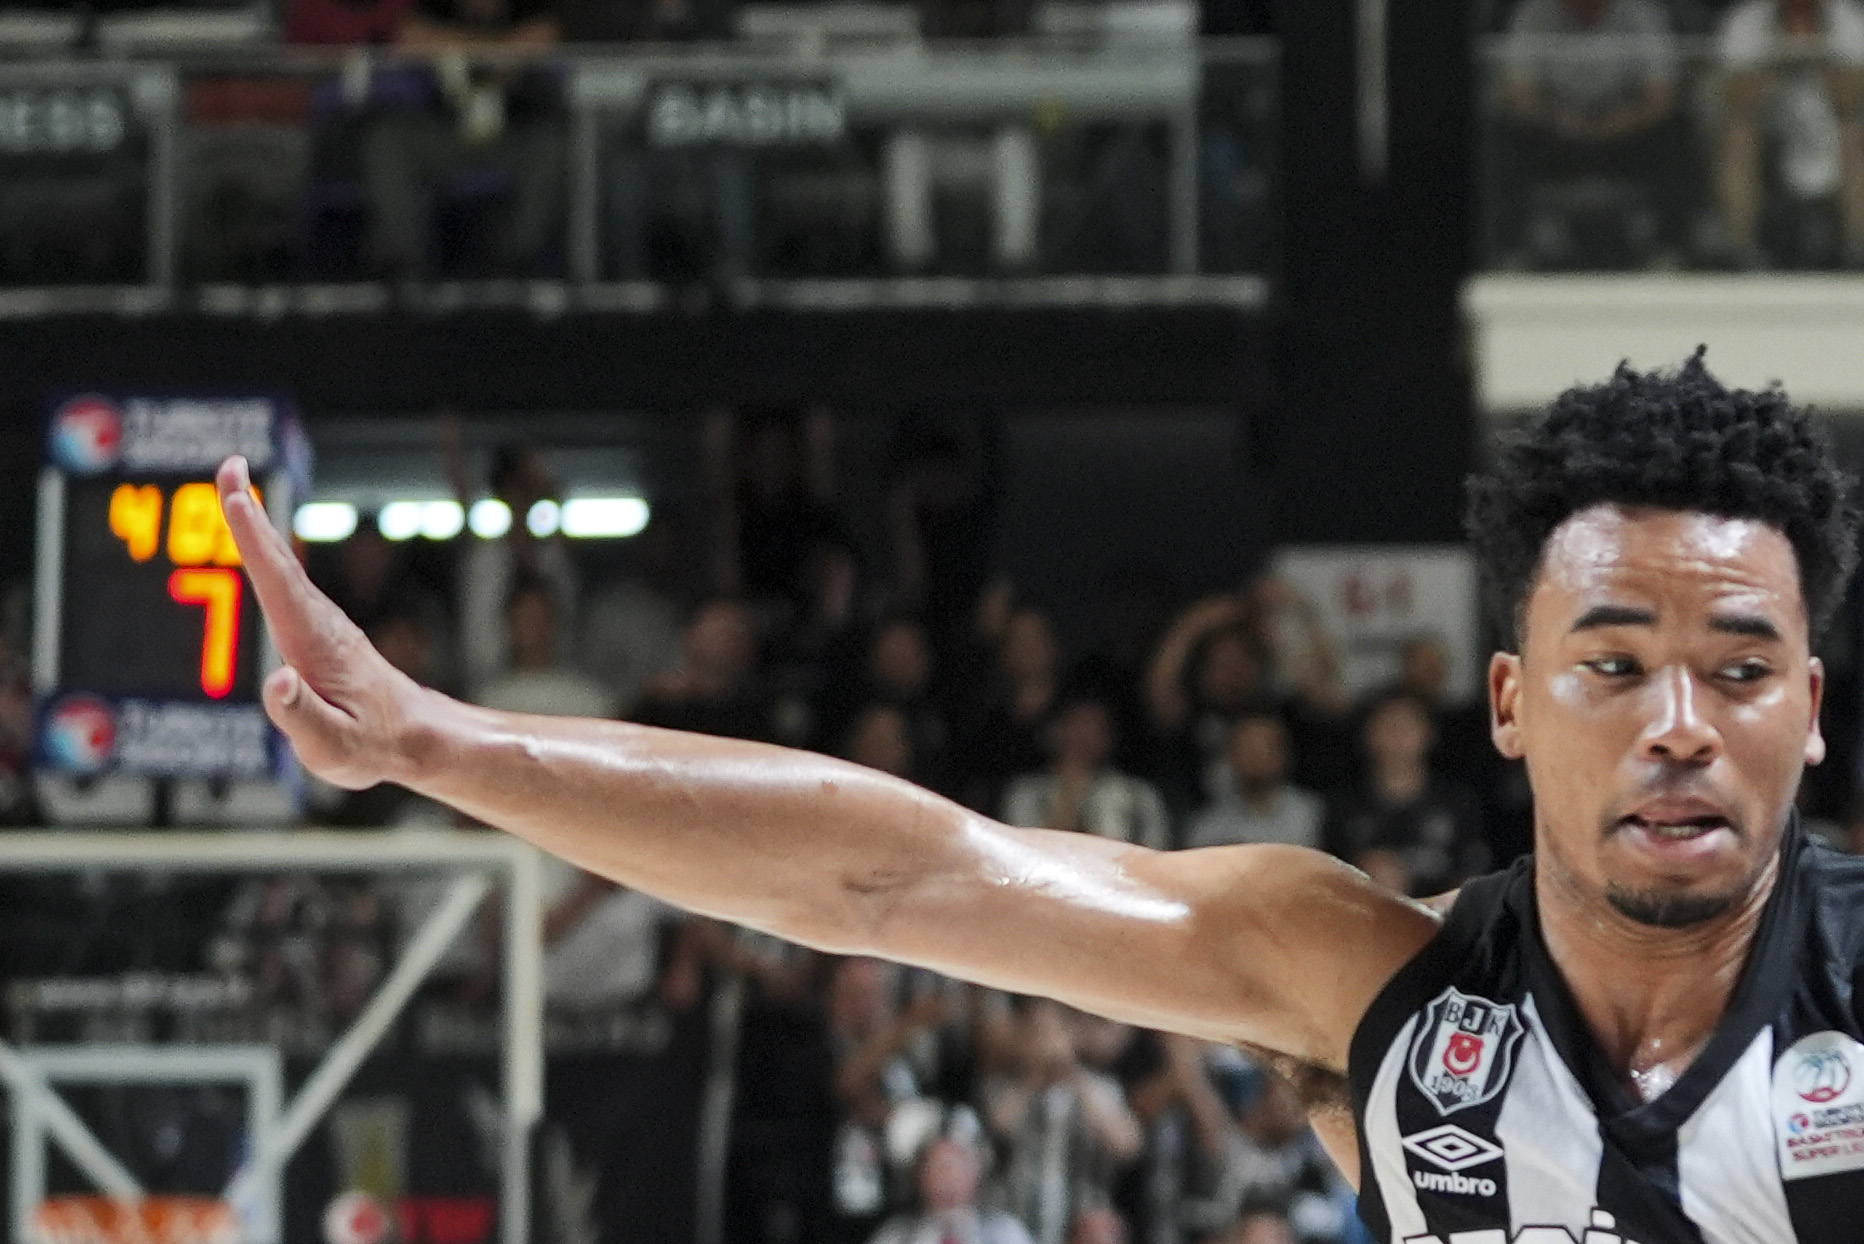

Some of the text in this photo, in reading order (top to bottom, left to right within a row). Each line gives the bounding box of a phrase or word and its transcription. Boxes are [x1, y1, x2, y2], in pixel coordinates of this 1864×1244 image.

[168, 568, 243, 698] 7
[1444, 1000, 1513, 1036] BJK
[1413, 1170, 1497, 1197] umbro
